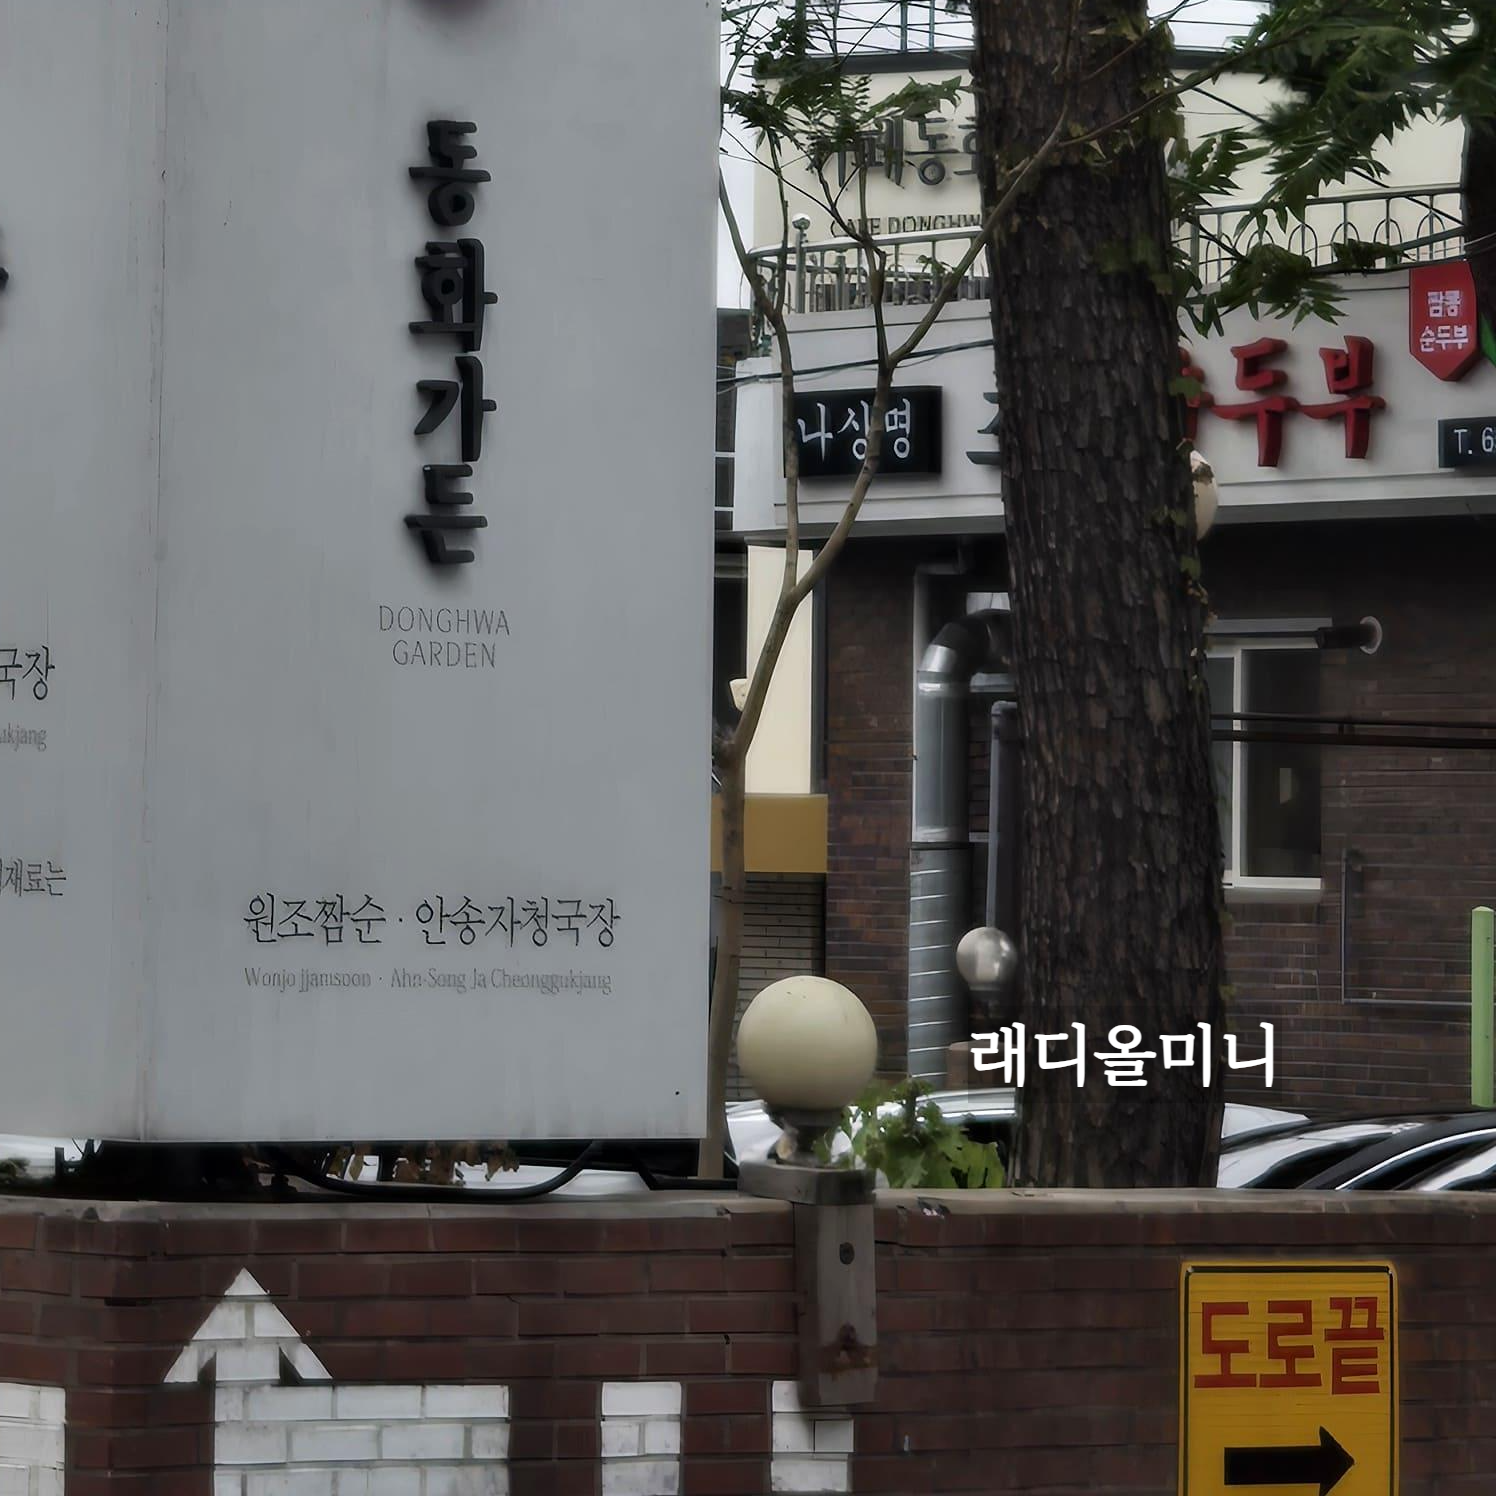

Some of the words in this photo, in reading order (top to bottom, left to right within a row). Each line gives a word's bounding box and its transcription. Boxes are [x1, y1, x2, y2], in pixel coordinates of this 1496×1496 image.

[408, 120, 498, 565] 동화가든
[1419, 325, 1469, 353] 순두부
[379, 605, 510, 636] DONGHWA
[393, 639, 496, 668] GARDEN
[244, 893, 386, 946] 원조짬순
[415, 895, 621, 947] 안송자청국장
[1194, 1297, 1385, 1394] 도로끝
